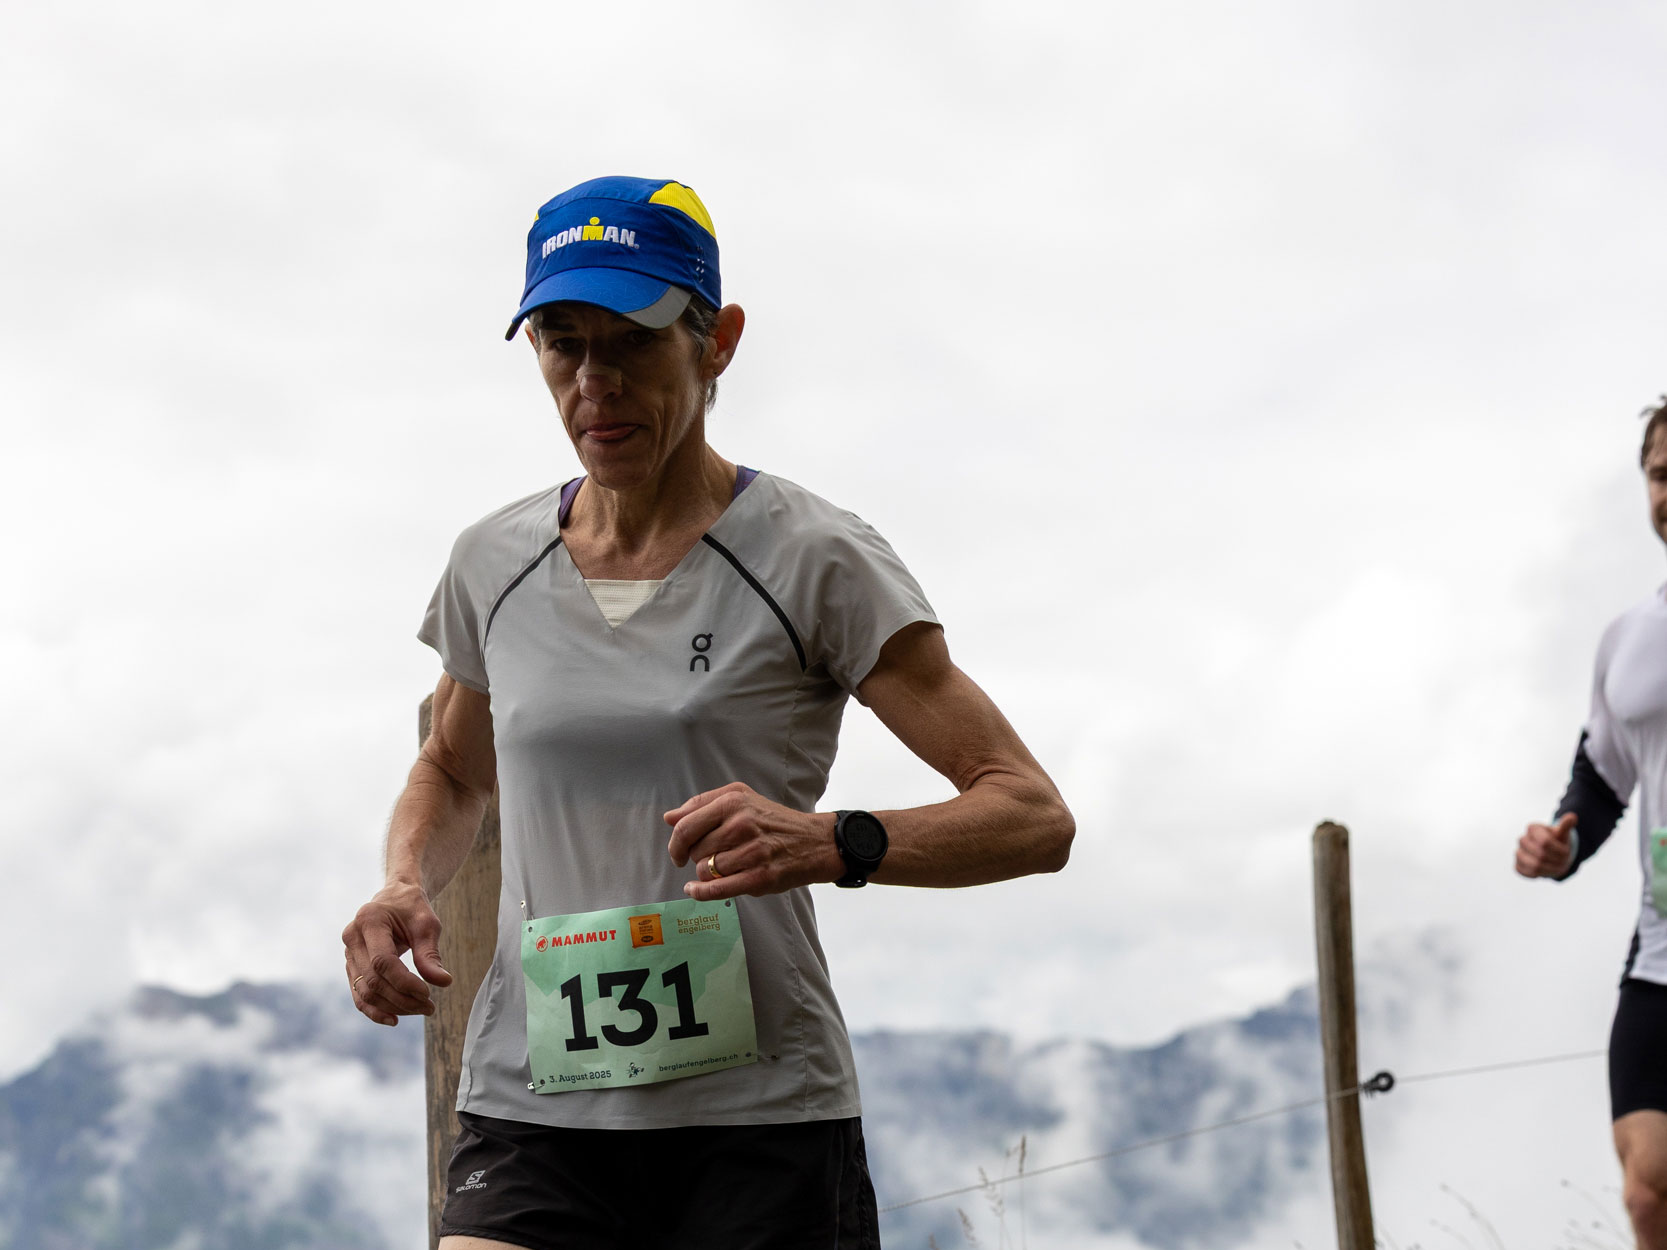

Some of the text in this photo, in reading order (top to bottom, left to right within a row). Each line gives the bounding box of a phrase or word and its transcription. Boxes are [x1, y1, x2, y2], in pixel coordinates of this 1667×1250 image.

[542, 217, 635, 260] IRONMAN
[677, 913, 719, 927] berglauf
[678, 922, 721, 935] engelberg
[551, 929, 617, 948] MAMMUT
[560, 960, 709, 1052] 131
[658, 1053, 738, 1072] berglaufengelberg.ch
[549, 1069, 612, 1084] 3. August 2025
